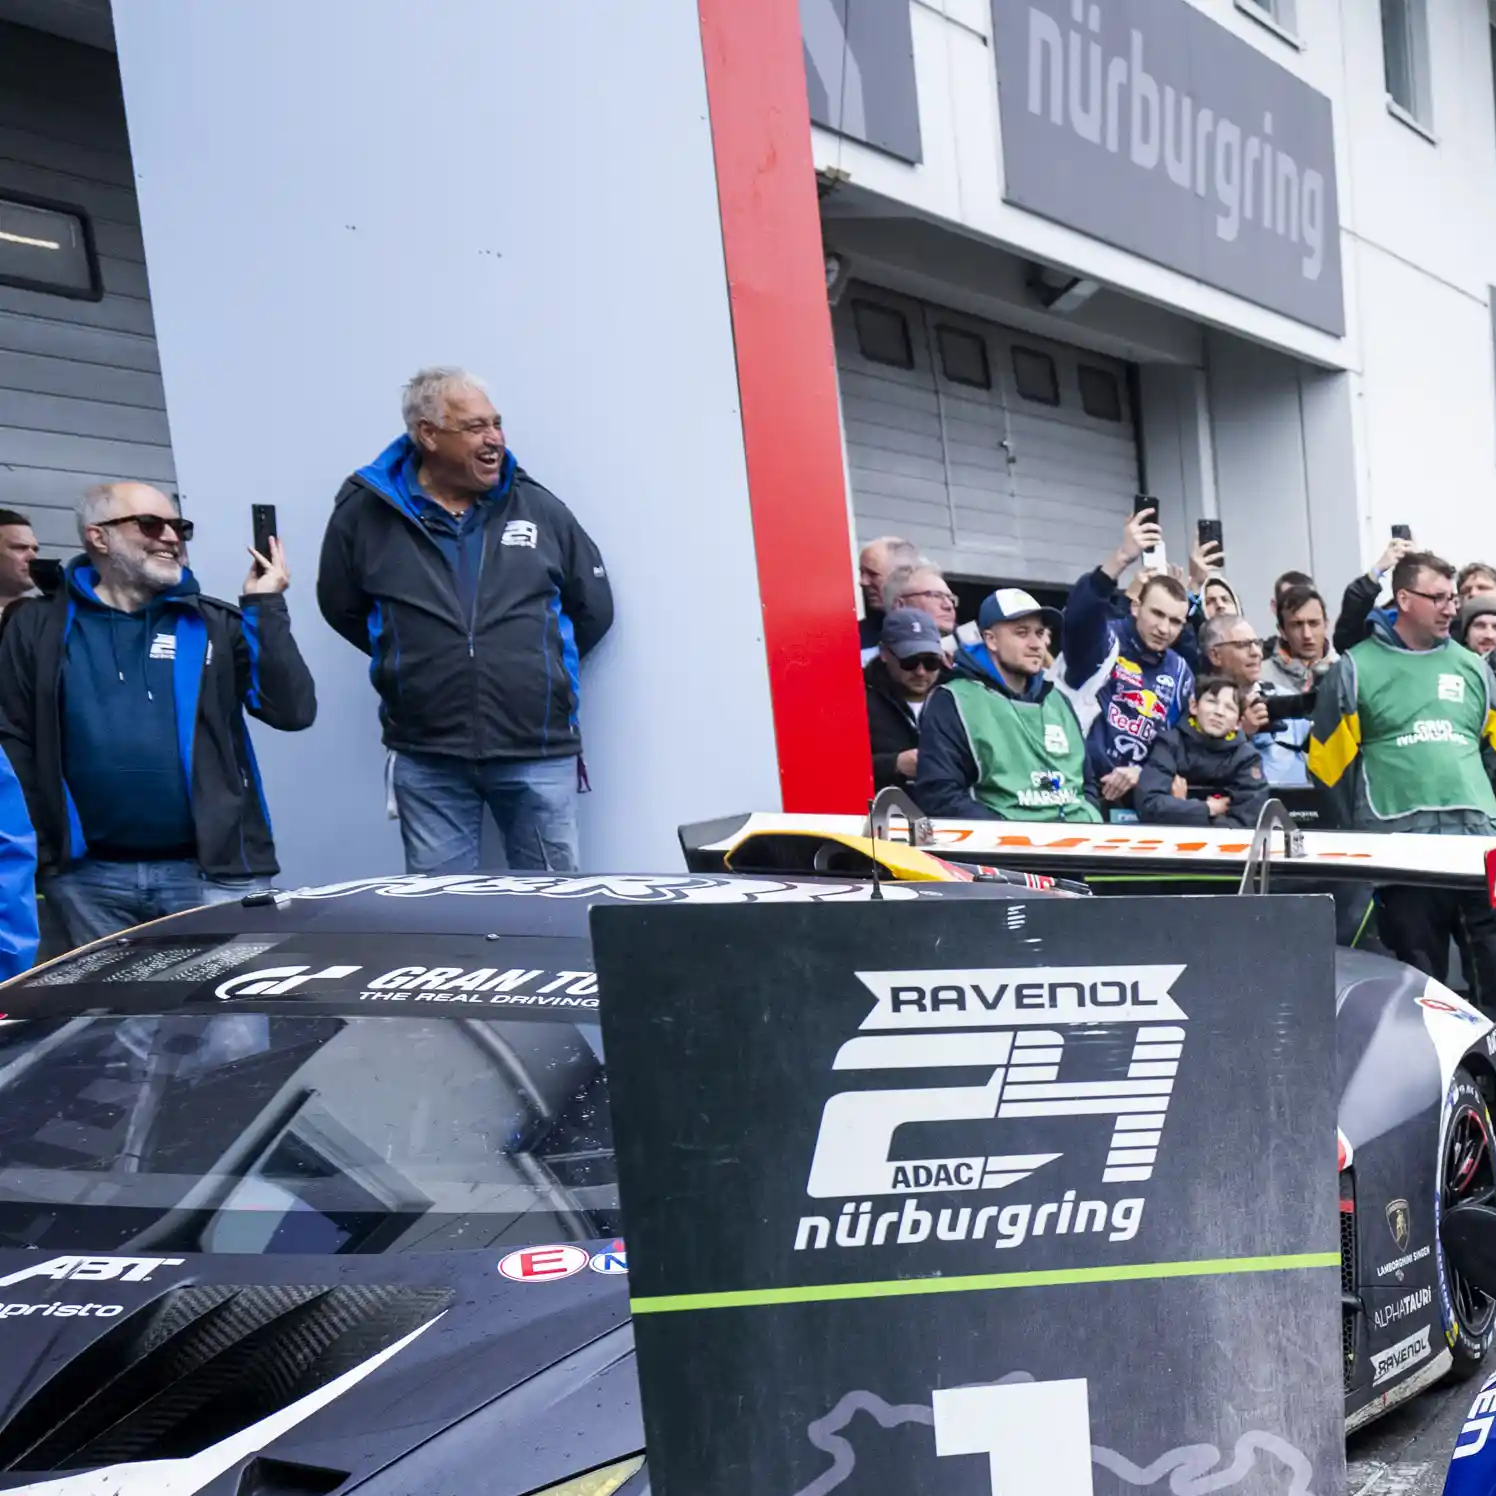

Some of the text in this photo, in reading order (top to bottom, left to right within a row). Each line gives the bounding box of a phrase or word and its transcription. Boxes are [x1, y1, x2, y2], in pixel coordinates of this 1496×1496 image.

[1027, 2, 1324, 280] nürburgring
[367, 966, 532, 993] GRAN
[359, 991, 600, 1009] THE REAL DRIVING
[889, 980, 1159, 1014] RAVENOL
[806, 1025, 1187, 1199] 24
[890, 1160, 975, 1190] ADAC
[793, 1189, 1146, 1251] nürburgring
[0, 1255, 185, 1287] ABT
[520, 1249, 566, 1277] E
[0, 1300, 124, 1319] pristo
[1377, 1337, 1428, 1376] RAVENOL
